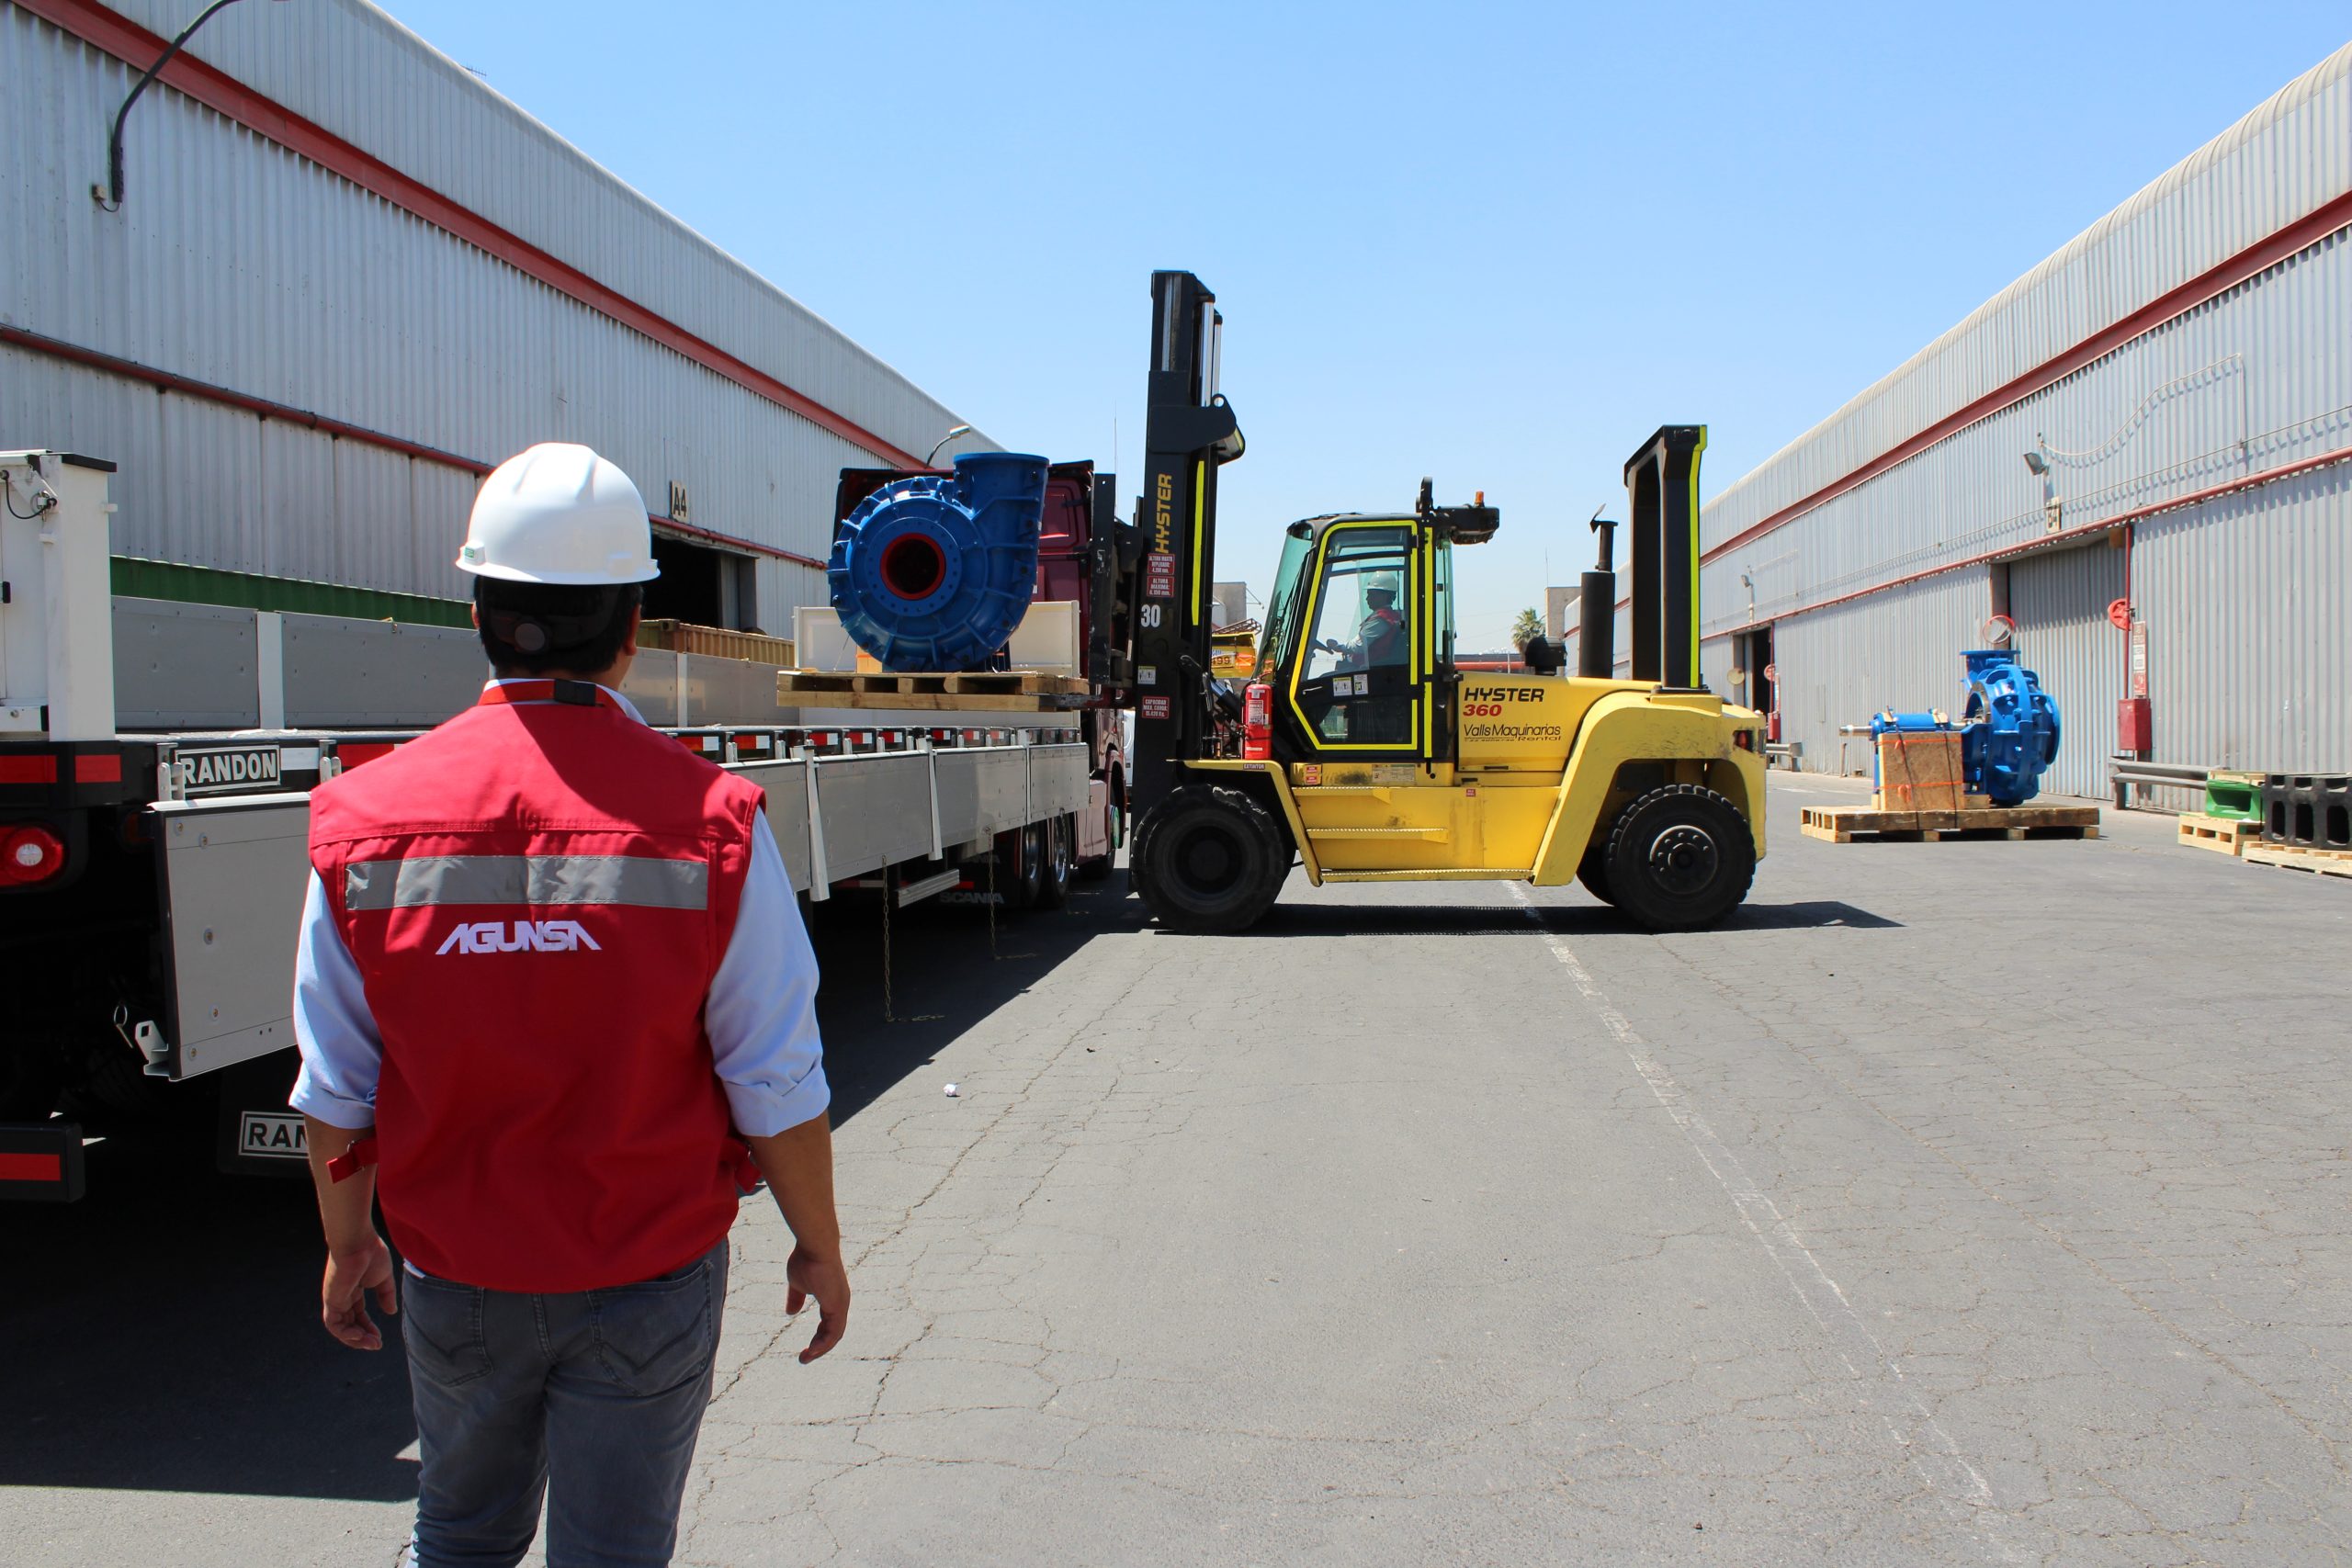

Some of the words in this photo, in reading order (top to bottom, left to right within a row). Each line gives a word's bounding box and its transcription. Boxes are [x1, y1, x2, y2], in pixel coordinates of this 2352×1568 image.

[673, 487, 686, 517] A4
[1155, 473, 1172, 554] HYSTER
[1140, 604, 1160, 627] 30
[1463, 704, 1502, 716] 360
[1464, 687, 1544, 703] HYSTER
[180, 753, 276, 784] RANDON
[435, 920, 602, 955] AGUNSA
